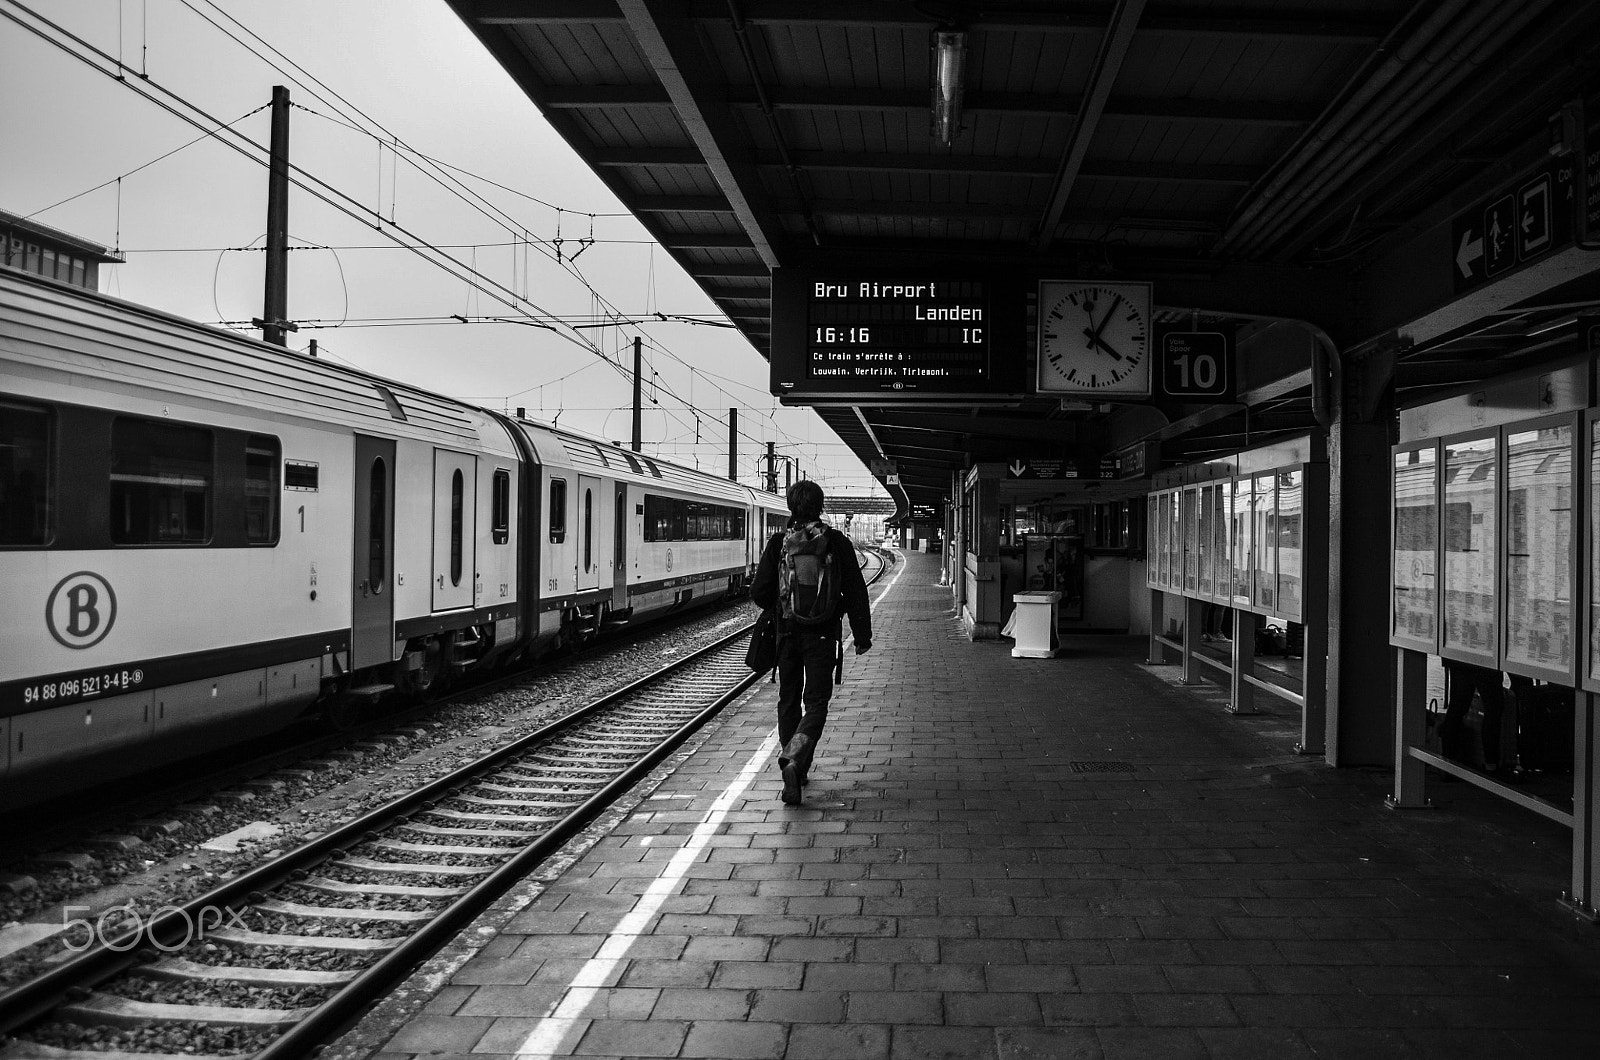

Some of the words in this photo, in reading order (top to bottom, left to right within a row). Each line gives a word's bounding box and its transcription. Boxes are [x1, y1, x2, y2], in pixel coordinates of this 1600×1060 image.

[815, 282, 847, 298] Bru
[860, 282, 936, 298] Airport
[915, 304, 982, 321] Landen
[816, 327, 870, 343] 16:16
[962, 328, 982, 343] IC
[813, 352, 824, 361] Ce
[827, 352, 851, 361] train
[1173, 354, 1217, 388] 10
[298, 505, 304, 533] 1
[500, 583, 509, 598] 521
[548, 578, 558, 592] 516
[24, 686, 39, 703] 94
[42, 683, 57, 700] 88
[59, 679, 80, 697] 096
[82, 676, 101, 695] 521
[103, 672, 119, 689] 3-4
